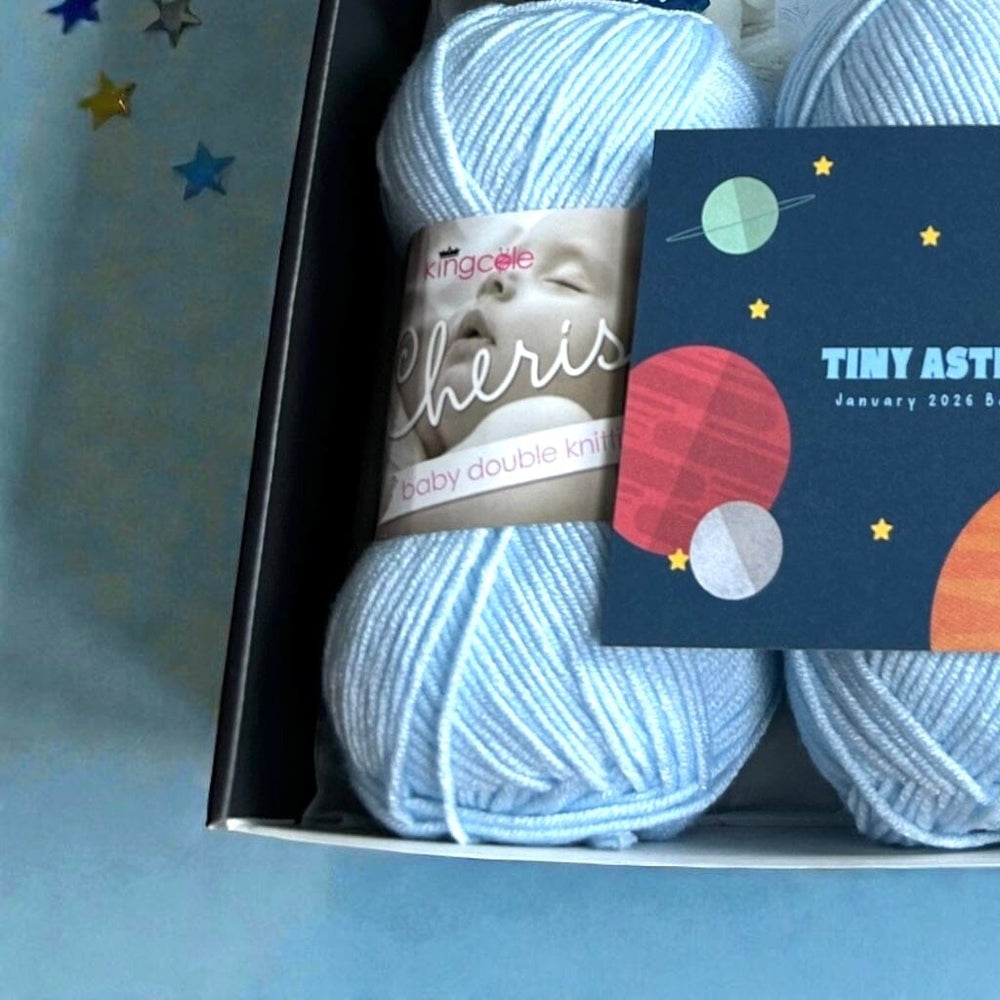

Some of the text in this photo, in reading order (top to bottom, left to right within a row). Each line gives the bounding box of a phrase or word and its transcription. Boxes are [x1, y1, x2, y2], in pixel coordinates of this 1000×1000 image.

[821, 346, 914, 380] TINY
[834, 392, 917, 412] January
[928, 392, 974, 408] 2026
[402, 466, 462, 502] baby
[467, 444, 558, 482] double
